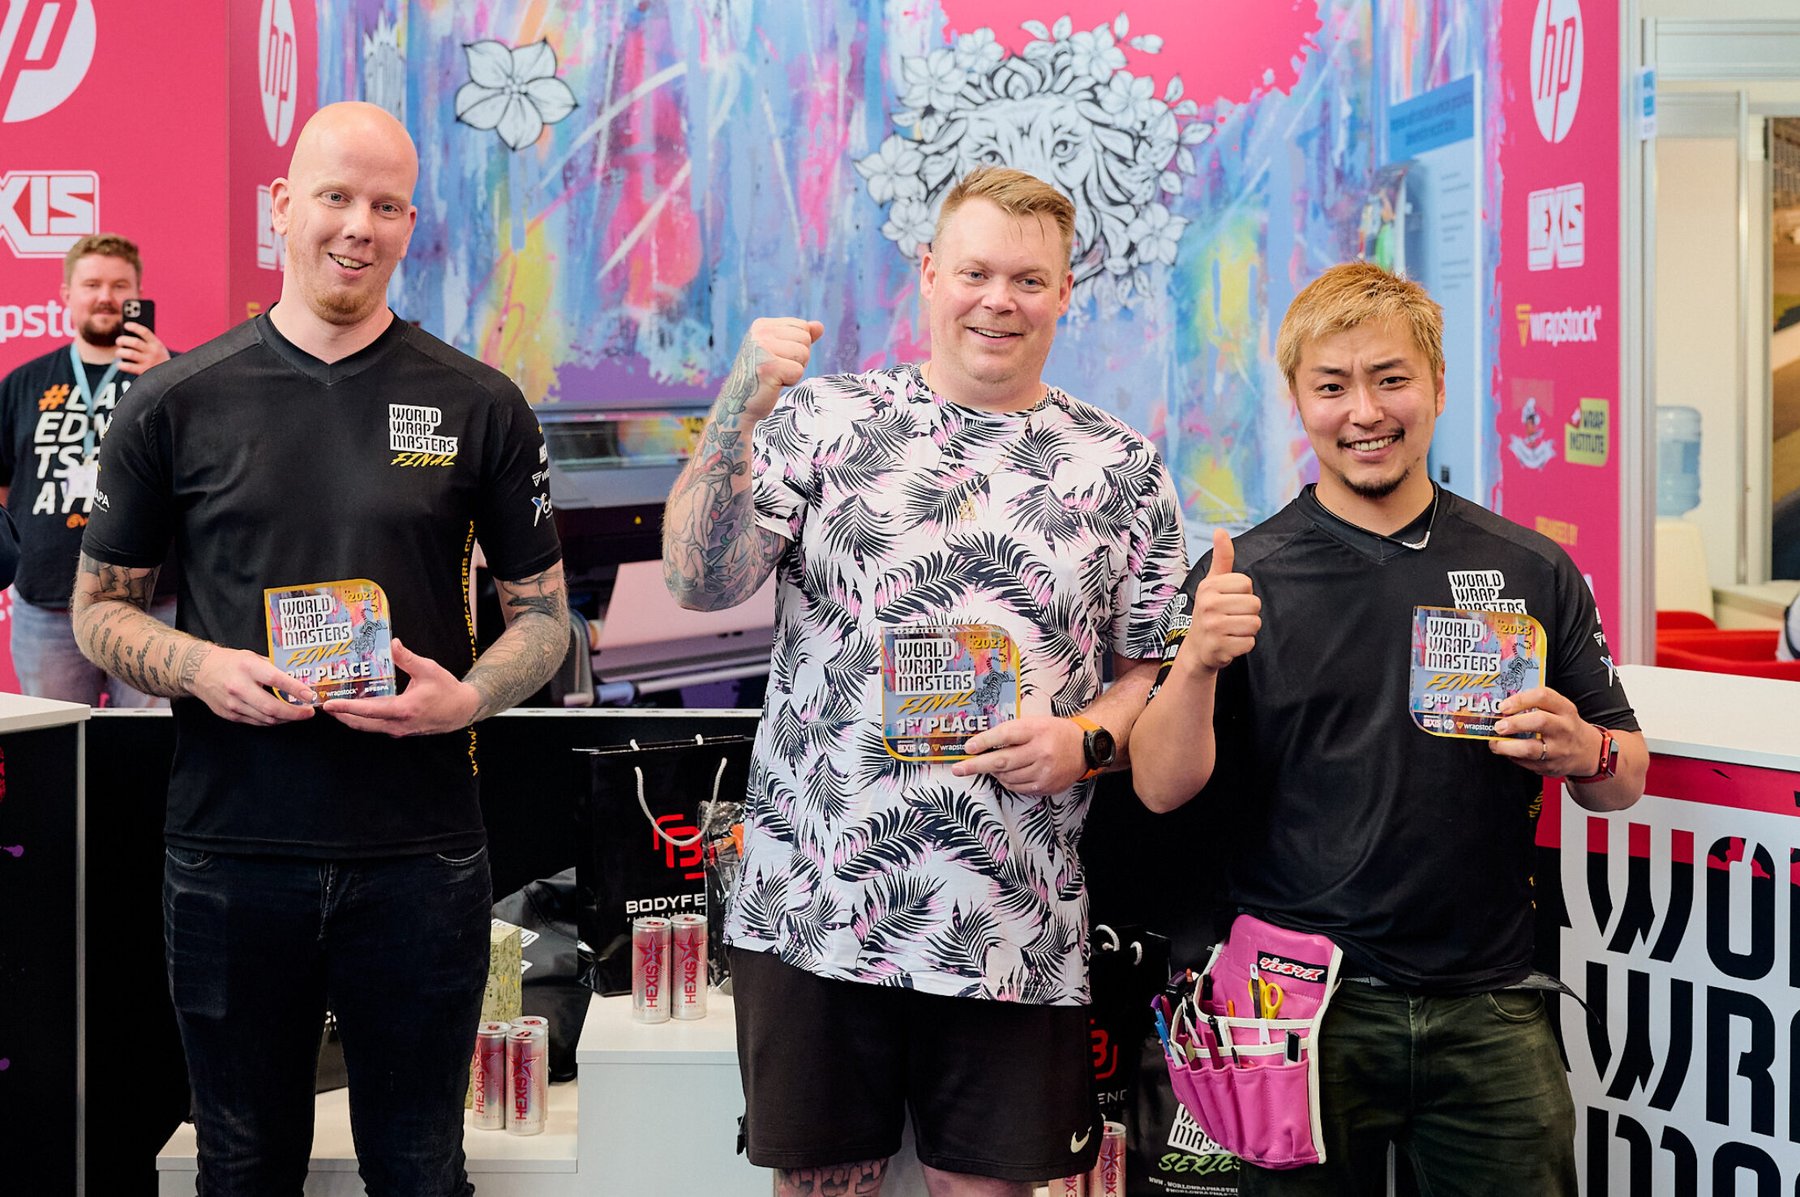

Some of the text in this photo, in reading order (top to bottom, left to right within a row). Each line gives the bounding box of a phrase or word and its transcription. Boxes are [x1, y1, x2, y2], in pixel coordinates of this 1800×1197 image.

[1530, 185, 1584, 262] HEXIS
[392, 407, 439, 424] WORLD
[392, 421, 431, 436] WRAP
[393, 434, 455, 453] MASTERS
[390, 452, 458, 467] FINAL
[1451, 573, 1501, 588] WORLD
[349, 591, 378, 602] 2023
[1455, 588, 1496, 602] WRAP
[282, 597, 331, 616] WORLD
[283, 613, 324, 631] WRAP
[1430, 620, 1481, 639] WORLD
[1501, 624, 1532, 636] 2023
[285, 625, 351, 647] MASTERS
[974, 637, 1007, 649] 2023
[1429, 636, 1472, 654] WRAP
[286, 640, 354, 668] FINAL
[898, 642, 952, 659] WORLD
[314, 661, 372, 682] PLACE
[898, 658, 943, 675] WRAP
[1428, 652, 1497, 672] MASTERS
[899, 673, 972, 692] MASTERS
[1425, 672, 1500, 691] FINAL
[896, 689, 976, 715] FINAL
[1423, 692, 1502, 714] 3RD PLAC
[896, 715, 989, 735] 1ST PLACE
[646, 965, 659, 1008] HEXIS
[685, 961, 697, 1004] HEXIS
[475, 1070, 485, 1114] HEXIS
[515, 1077, 528, 1120] HEXIS
